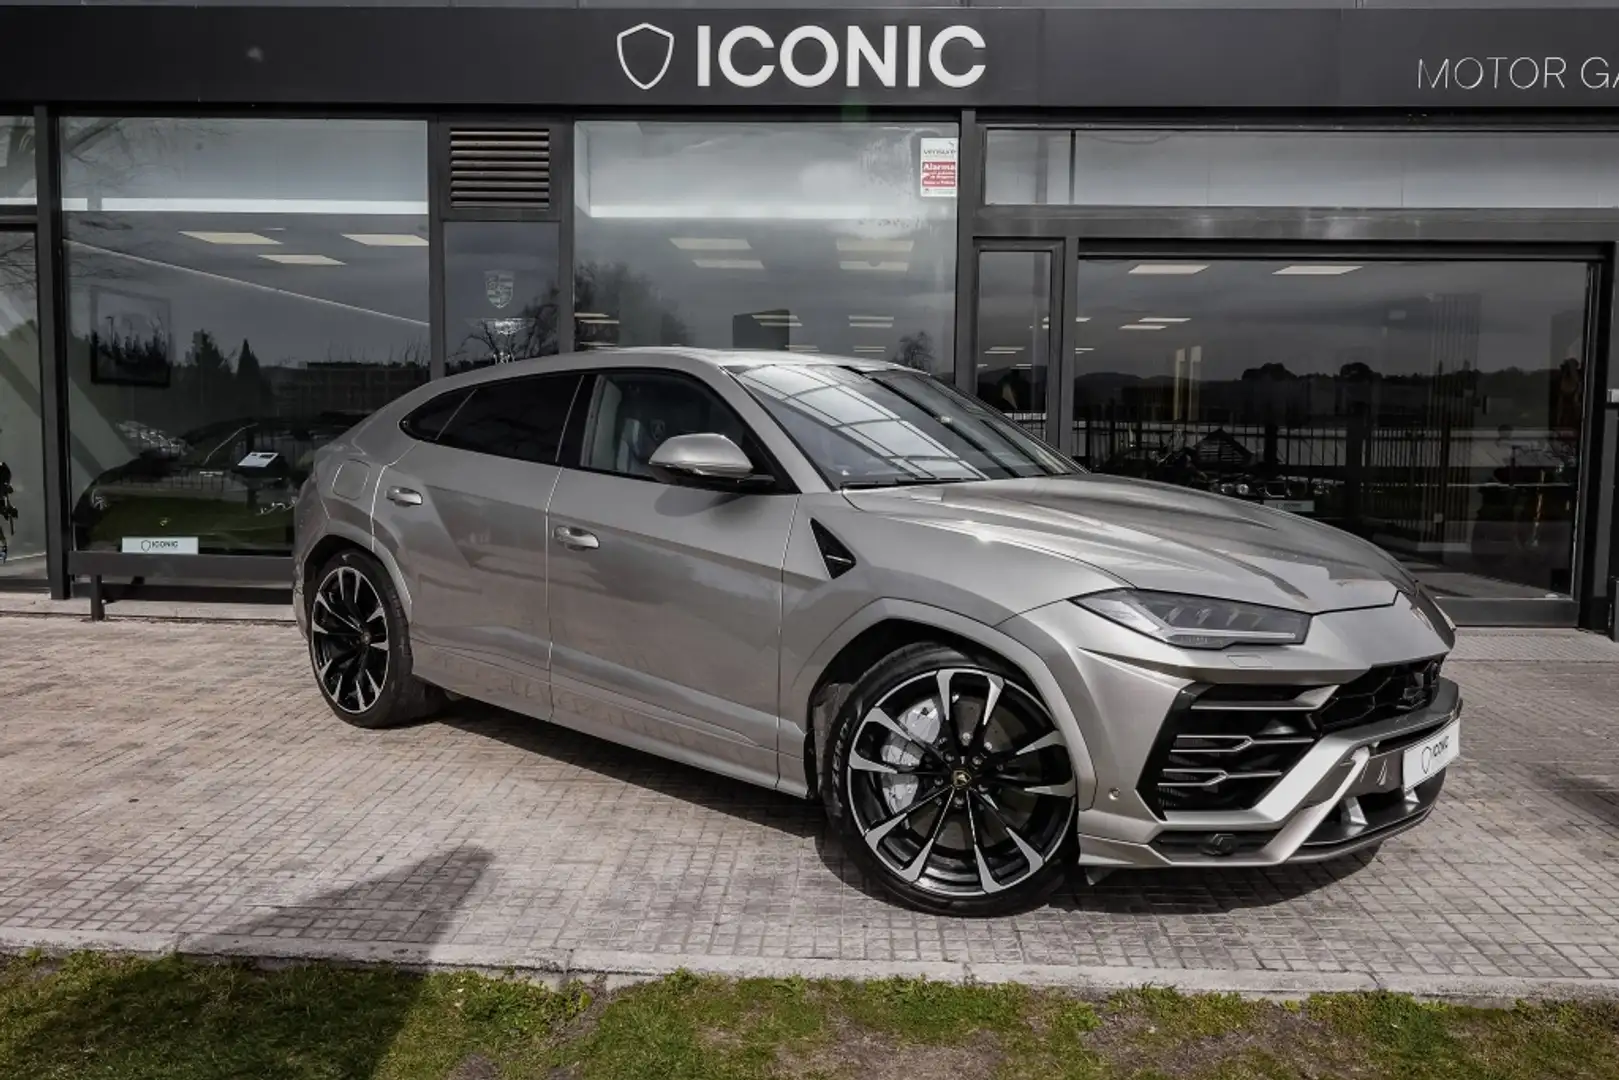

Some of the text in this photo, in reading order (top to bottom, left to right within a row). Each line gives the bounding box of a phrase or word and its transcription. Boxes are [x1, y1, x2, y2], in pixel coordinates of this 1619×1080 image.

[697, 25, 986, 87] ICONIC
[1417, 56, 1619, 90] MOTOR G
